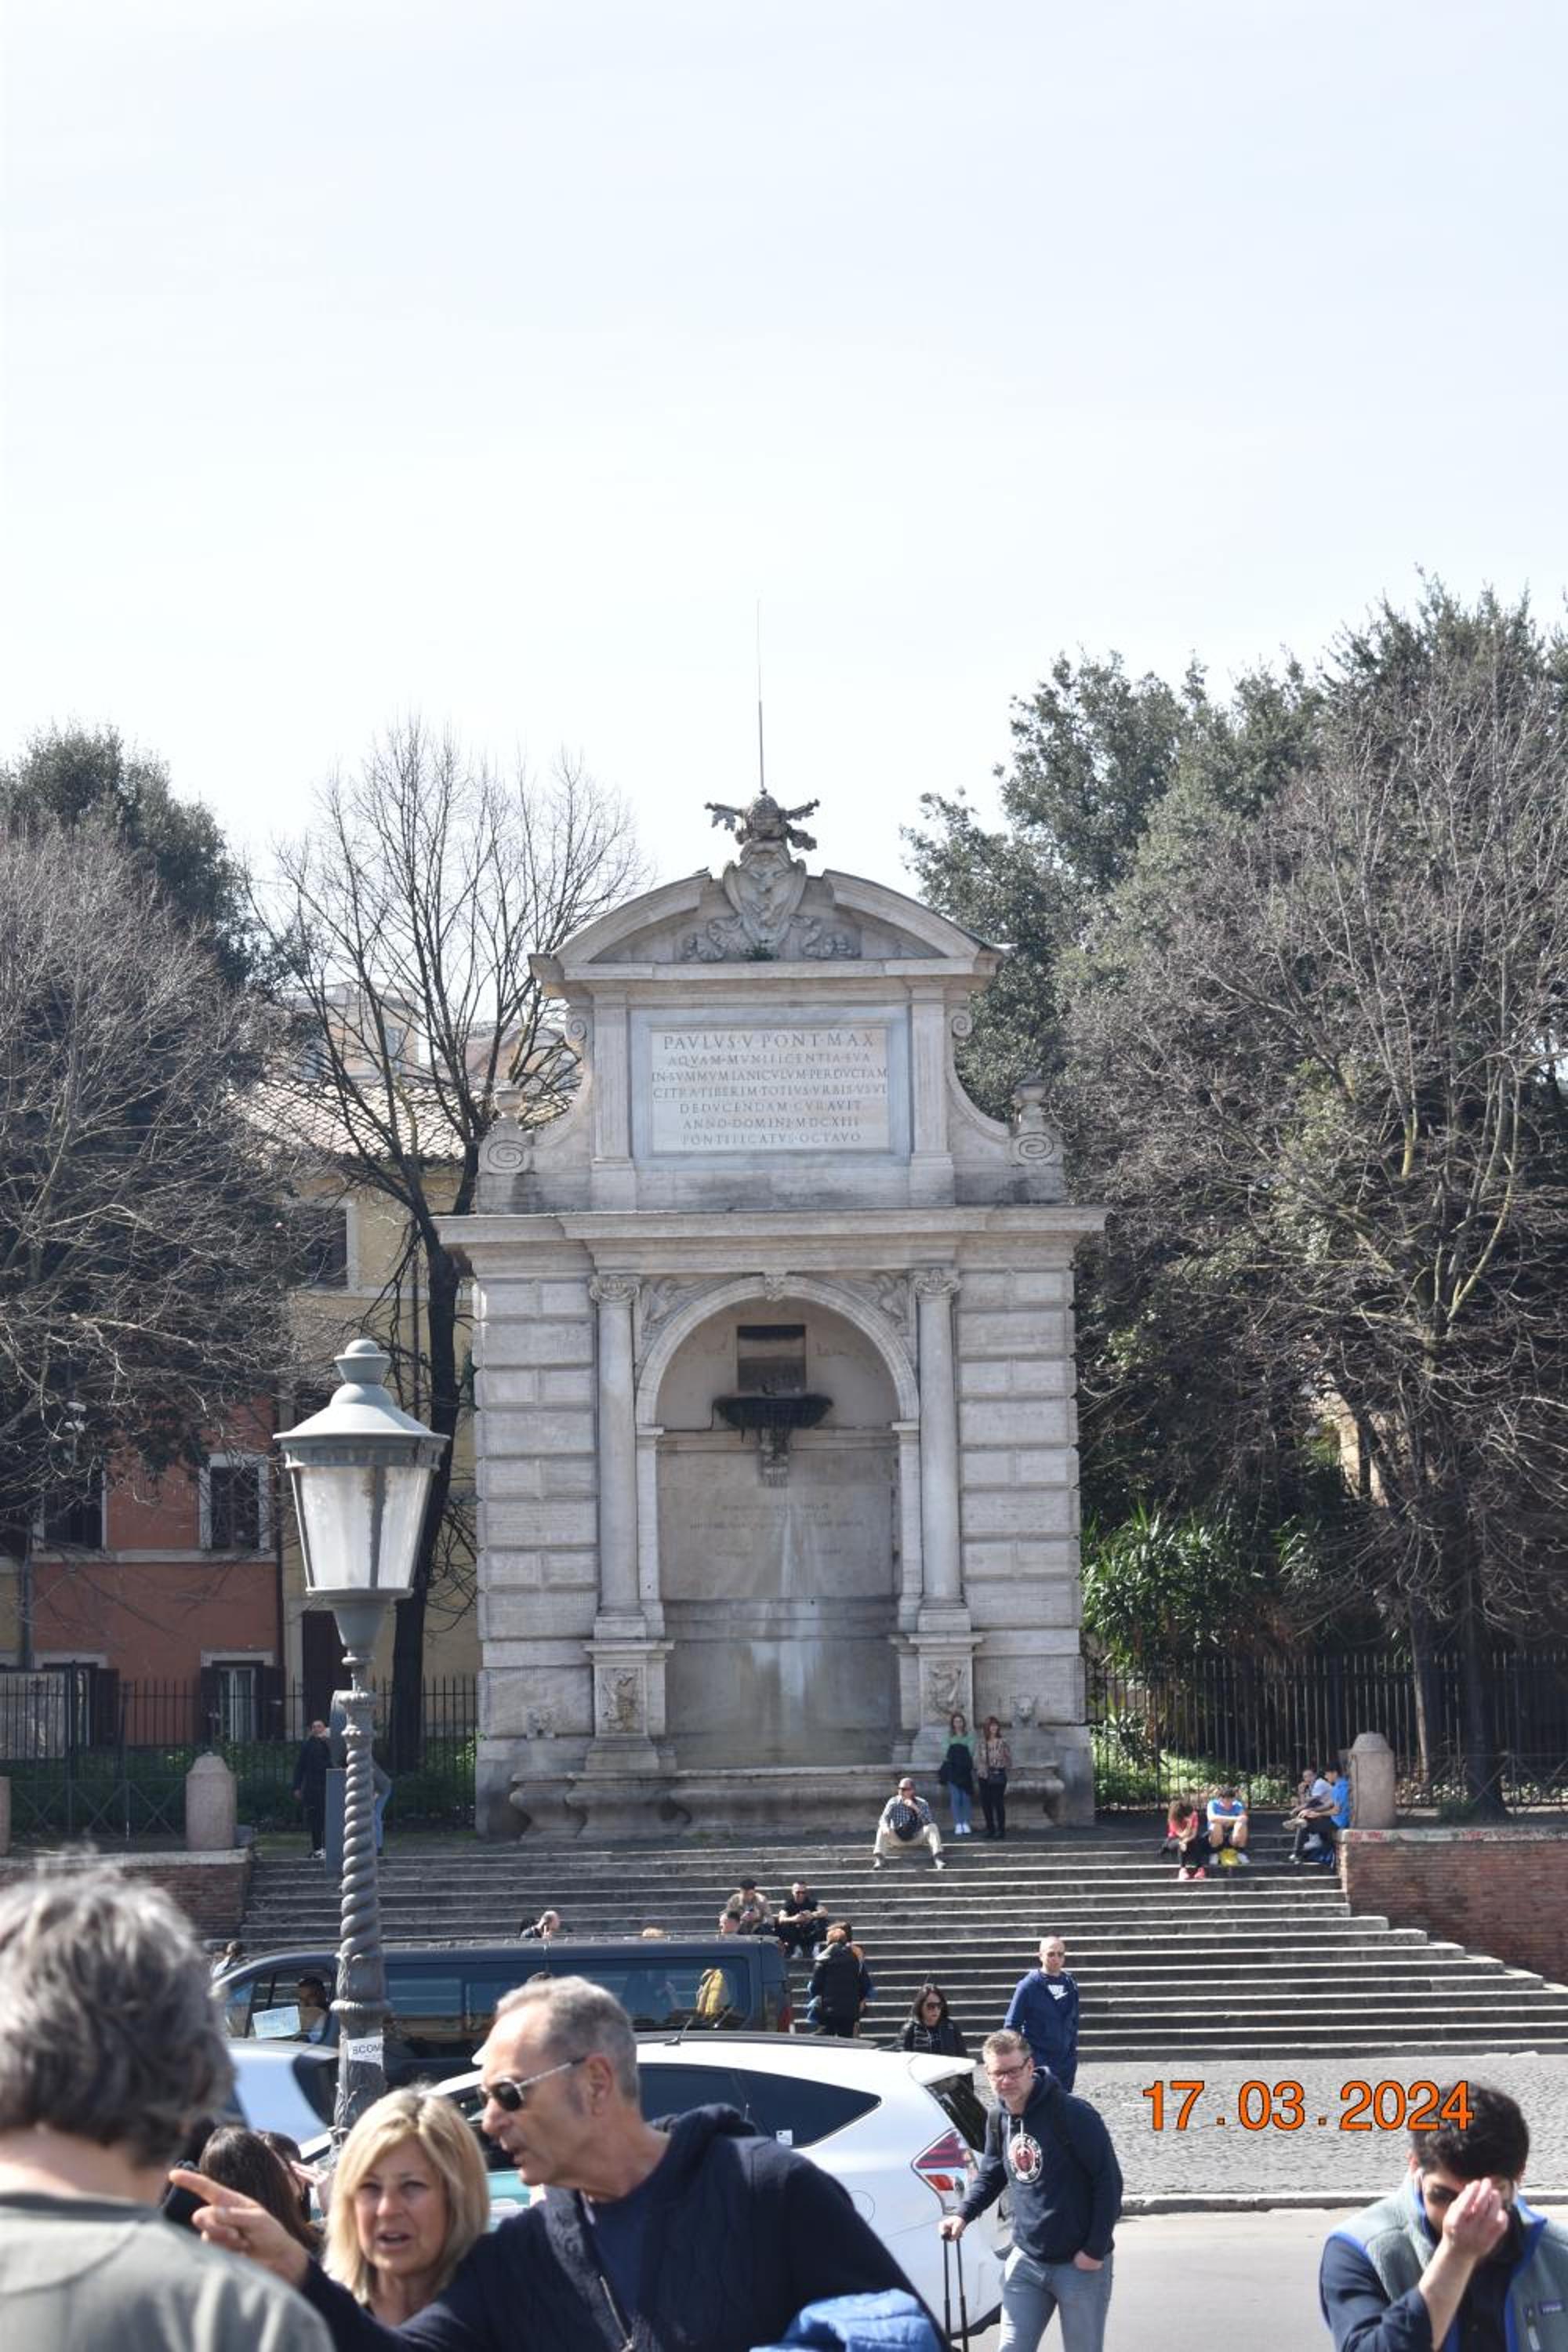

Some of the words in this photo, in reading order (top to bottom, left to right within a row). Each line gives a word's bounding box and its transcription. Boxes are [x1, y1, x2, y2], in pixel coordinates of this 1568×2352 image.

[664, 1035, 735, 1049] PAVLVS
[762, 1033, 821, 1048] PONT
[827, 1032, 874, 1047] MAX
